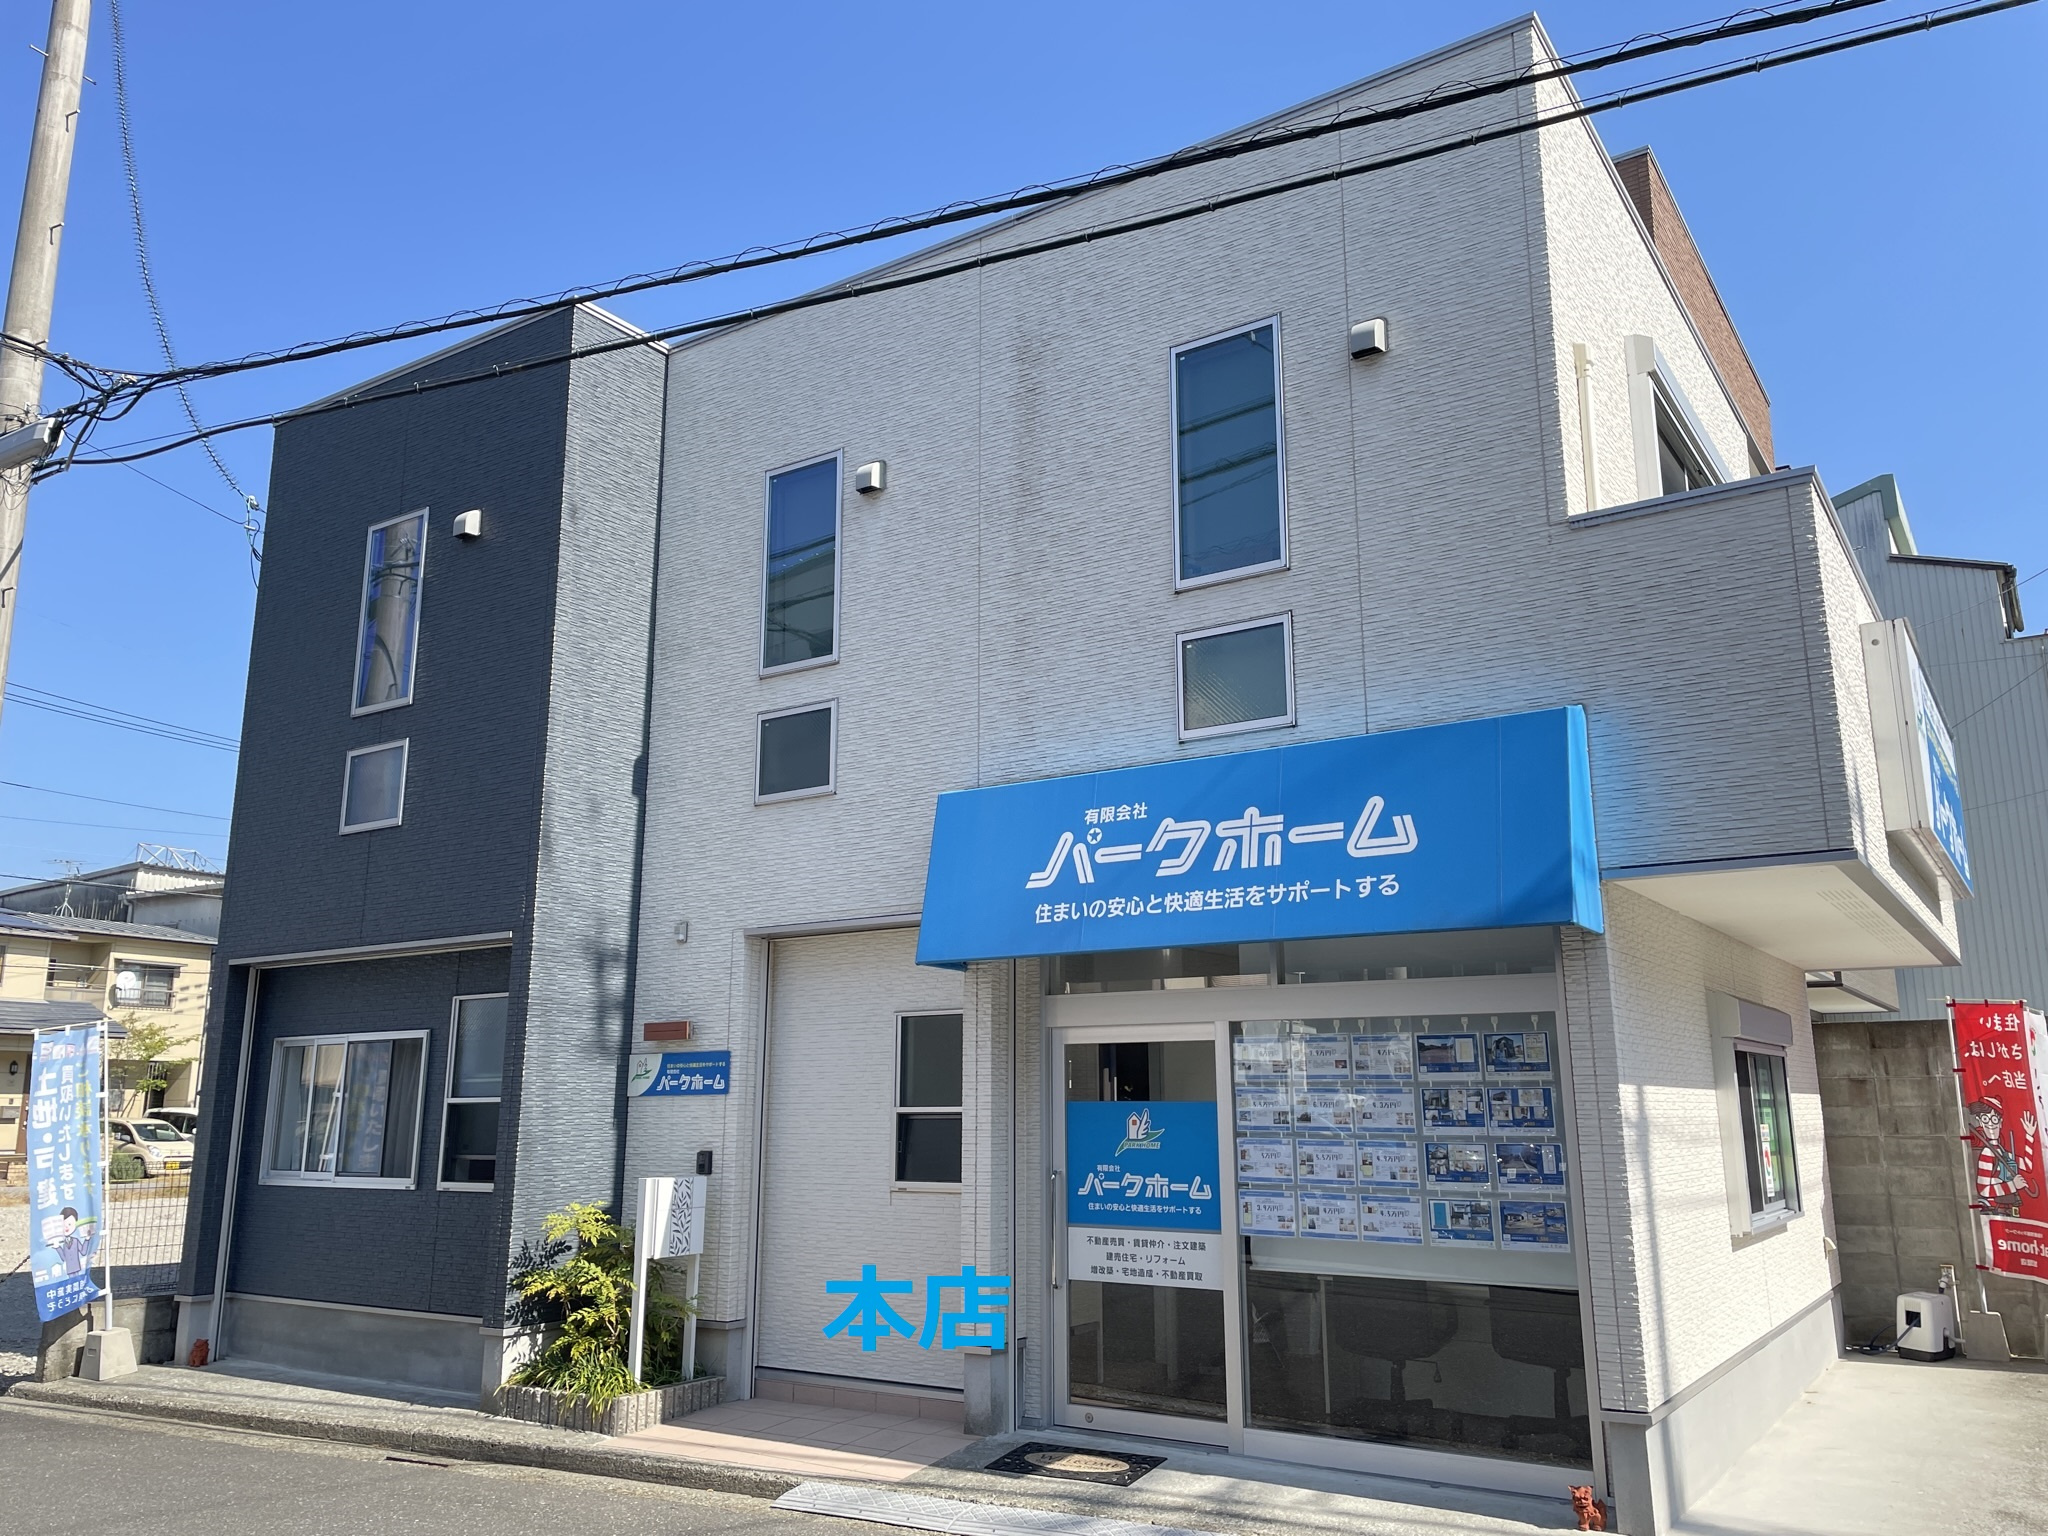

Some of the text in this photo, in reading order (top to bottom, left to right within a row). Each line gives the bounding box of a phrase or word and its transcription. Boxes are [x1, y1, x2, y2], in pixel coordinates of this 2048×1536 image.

[1084, 802, 1148, 824] 有限会社
[1025, 795, 1418, 890] パークホーム
[1034, 873, 1400, 924] 住まいの安心と快適生活をサポートする
[656, 1073, 725, 1091] パークホーム
[1078, 1172, 1212, 1200] パークホーム
[1088, 1203, 1202, 1215] 住まいの安心と快適生活をサポートする
[1106, 1252, 1186, 1266] 建売住宅・リフォーム
